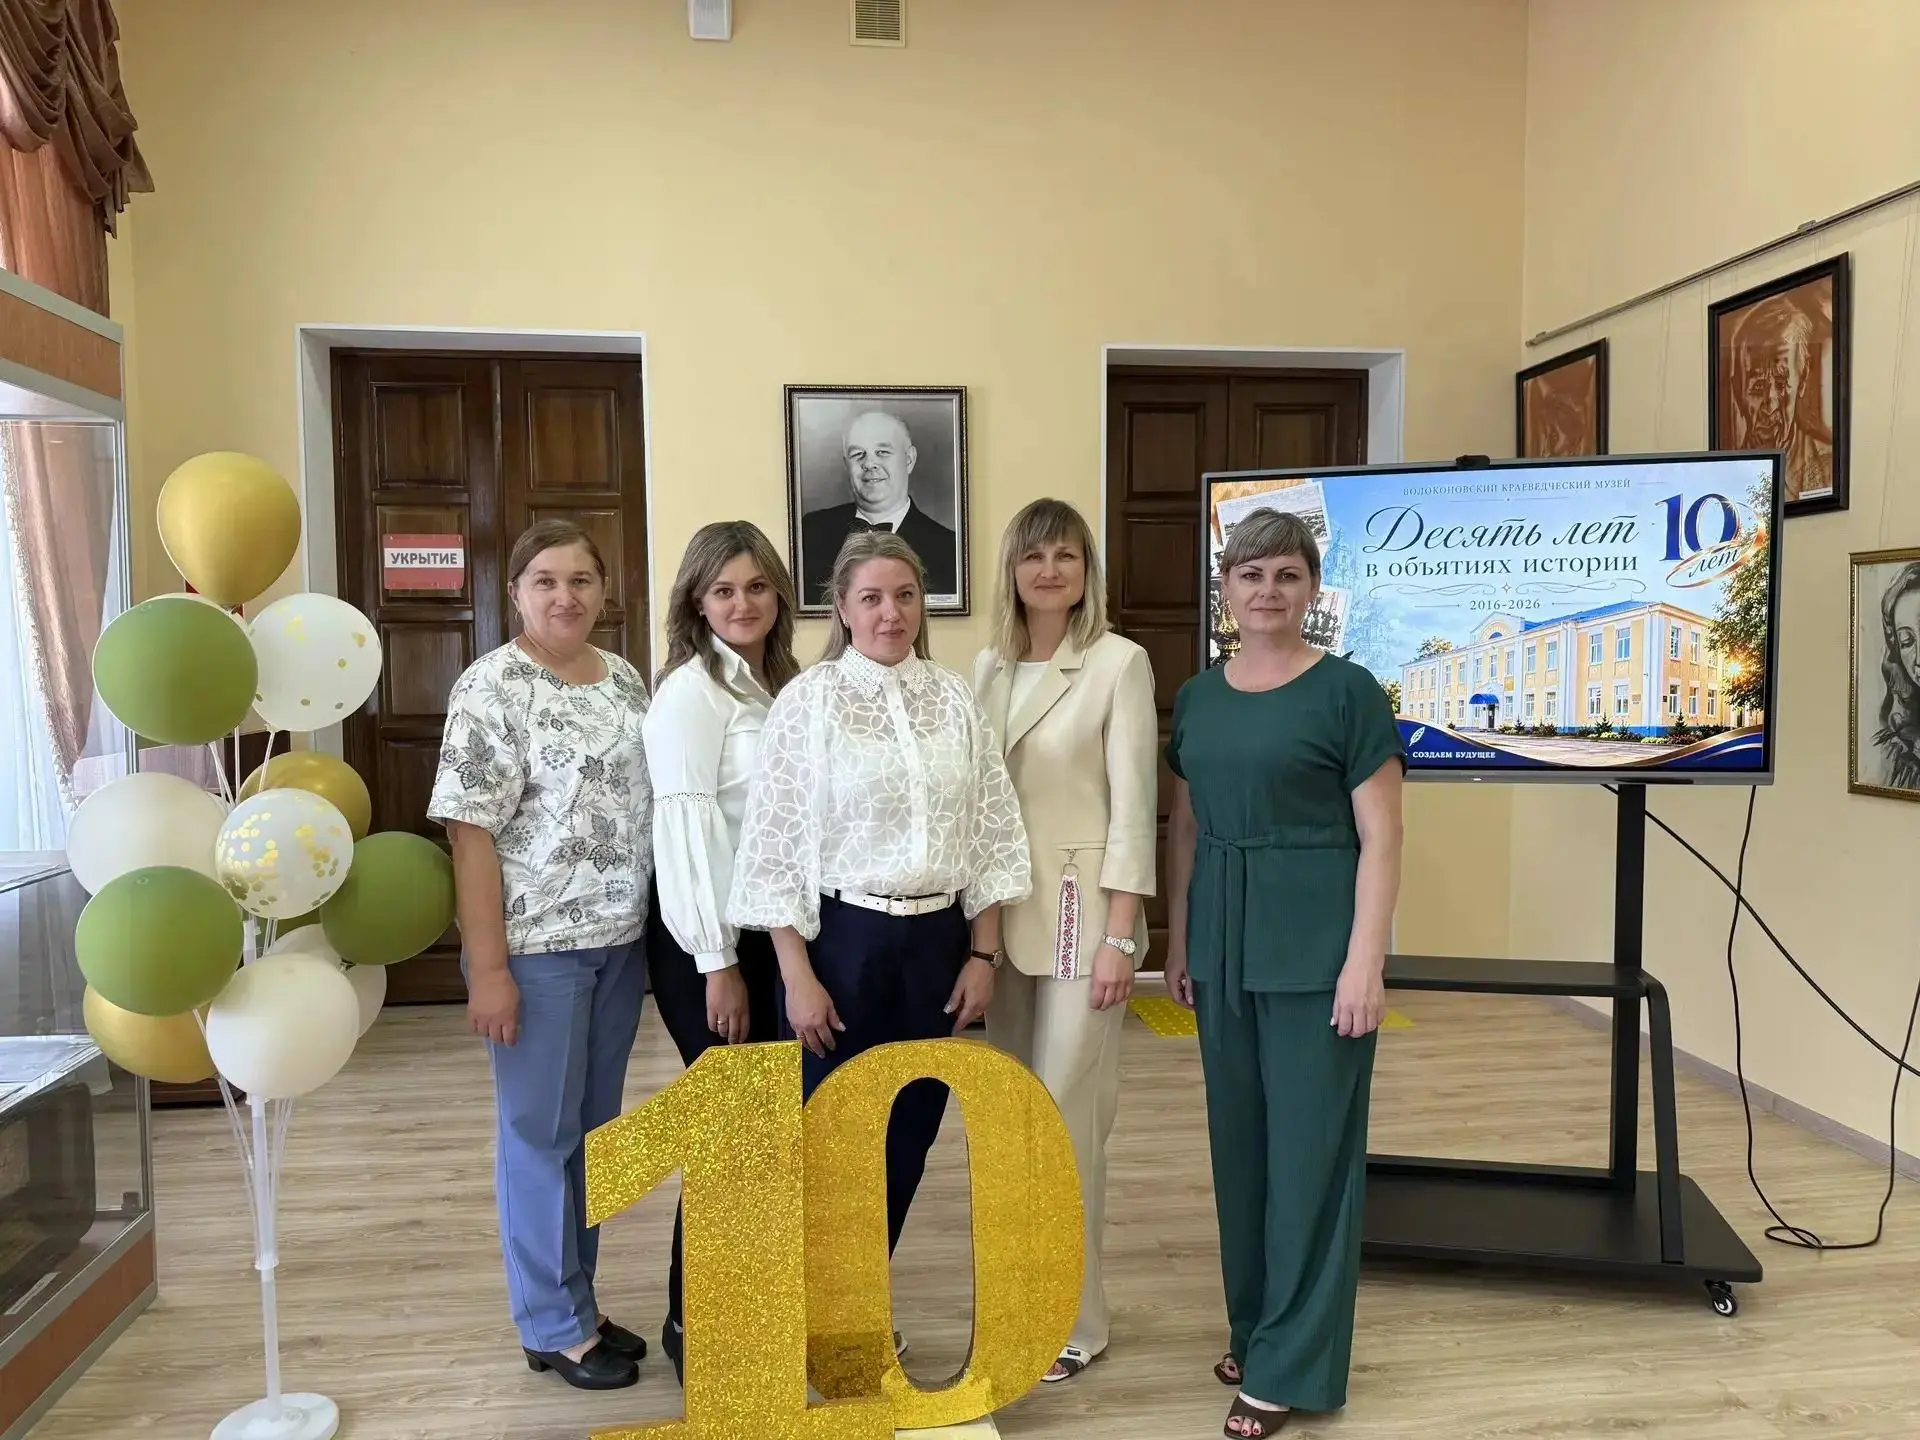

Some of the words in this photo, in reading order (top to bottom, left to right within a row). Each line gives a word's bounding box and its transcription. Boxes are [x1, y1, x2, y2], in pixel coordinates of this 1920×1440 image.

[1402, 484, 1498, 496] ВОЛОКОНОВСКИЙ
[1502, 480, 1592, 492] КРАЕВЕДЧЕСКИЙ
[1594, 477, 1631, 490] МУЗЕЙ
[1362, 502, 1543, 554] Десять
[1552, 514, 1640, 546] лет
[1654, 492, 1742, 562] 10
[390, 552, 458, 565] УКРЫТИЕ
[1366, 563, 1378, 578] в
[1388, 555, 1513, 577] объятиях
[1523, 554, 1638, 578] истории
[1688, 547, 1738, 578] лет
[1469, 598, 1542, 612] 2016-2026
[1412, 751, 1453, 759] СОЗДАЕМ
[1455, 751, 1496, 759] БУДУЩЕЕ
[584, 1037, 1086, 1440] 10
